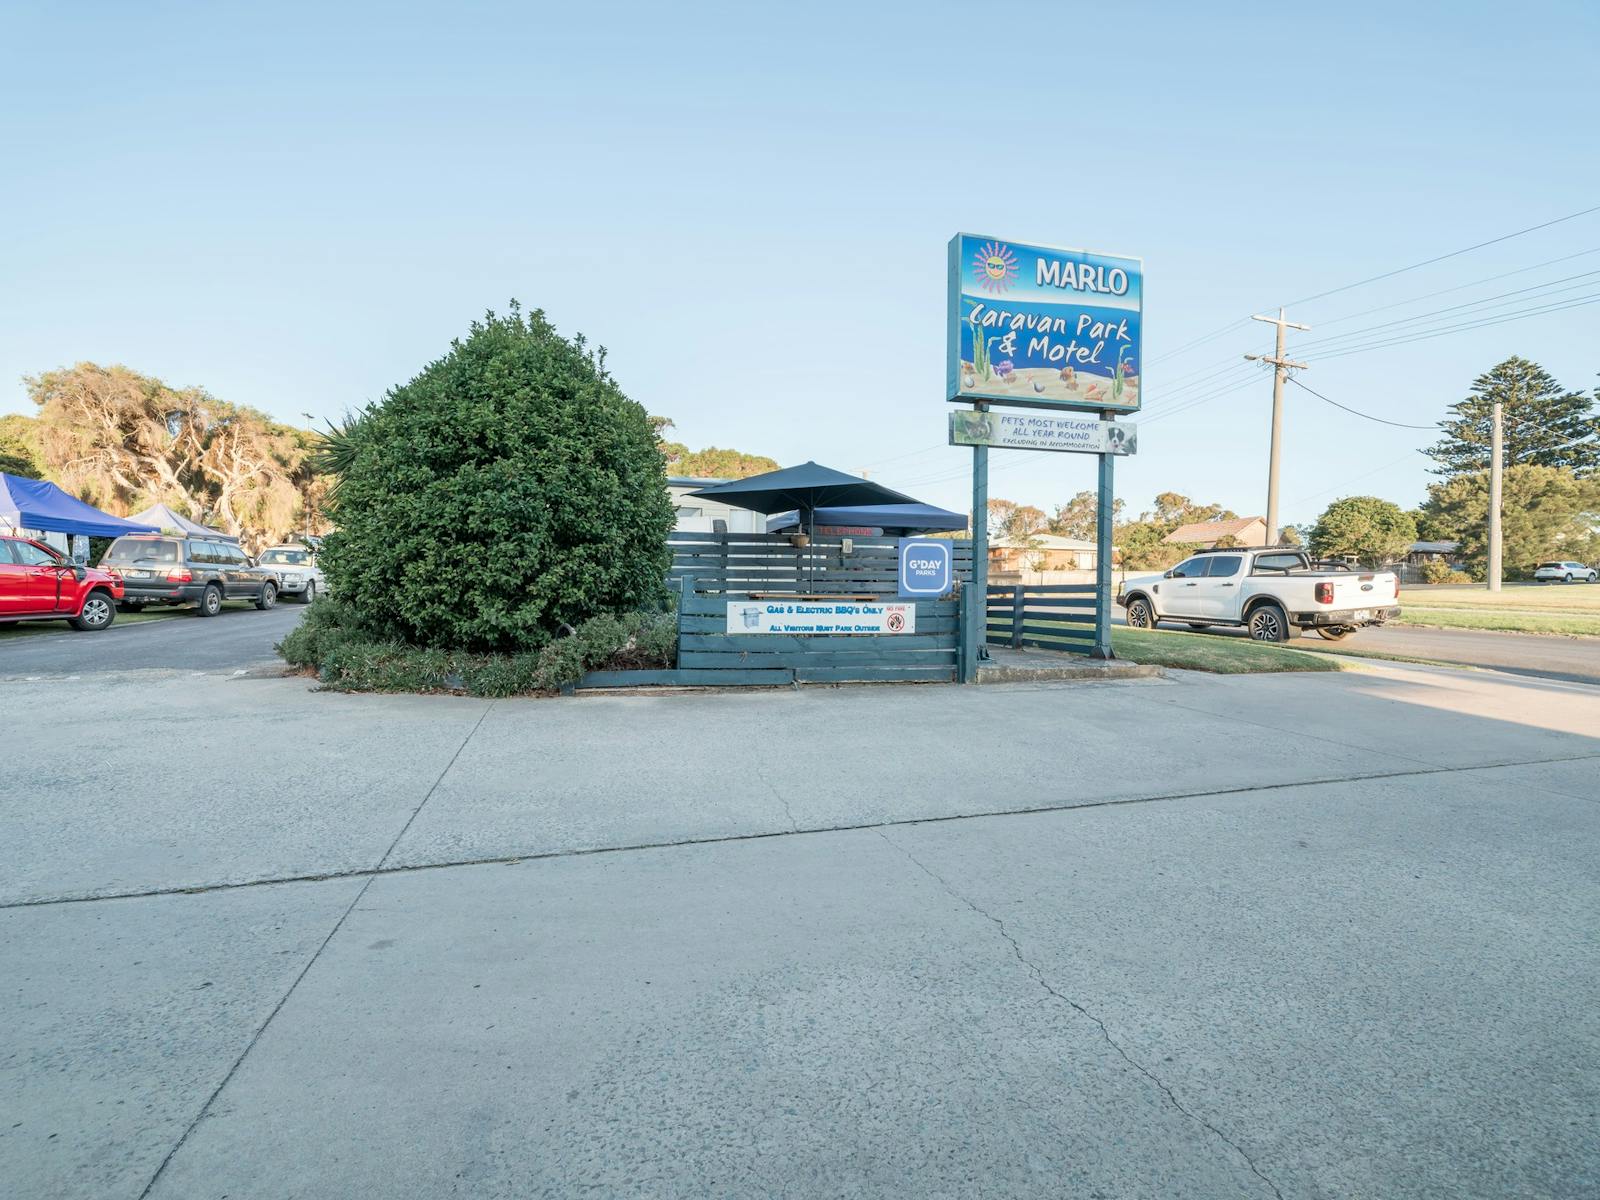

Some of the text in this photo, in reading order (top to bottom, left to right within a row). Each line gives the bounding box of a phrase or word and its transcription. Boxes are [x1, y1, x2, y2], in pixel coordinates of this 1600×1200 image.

[1036, 258, 1128, 296] MARLO
[969, 303, 1132, 341] Caravan Park
[999, 331, 1105, 364] & Motel
[1001, 416, 1100, 431] PETS MOST WELCOME
[1013, 427, 1090, 440] ALL YEAR ROUND
[909, 560, 942, 569] G'DAY
[766, 605, 785, 614] GAS
[787, 606, 794, 614] &
[796, 605, 833, 614] ELECTRIC
[862, 605, 884, 615] ONLY
